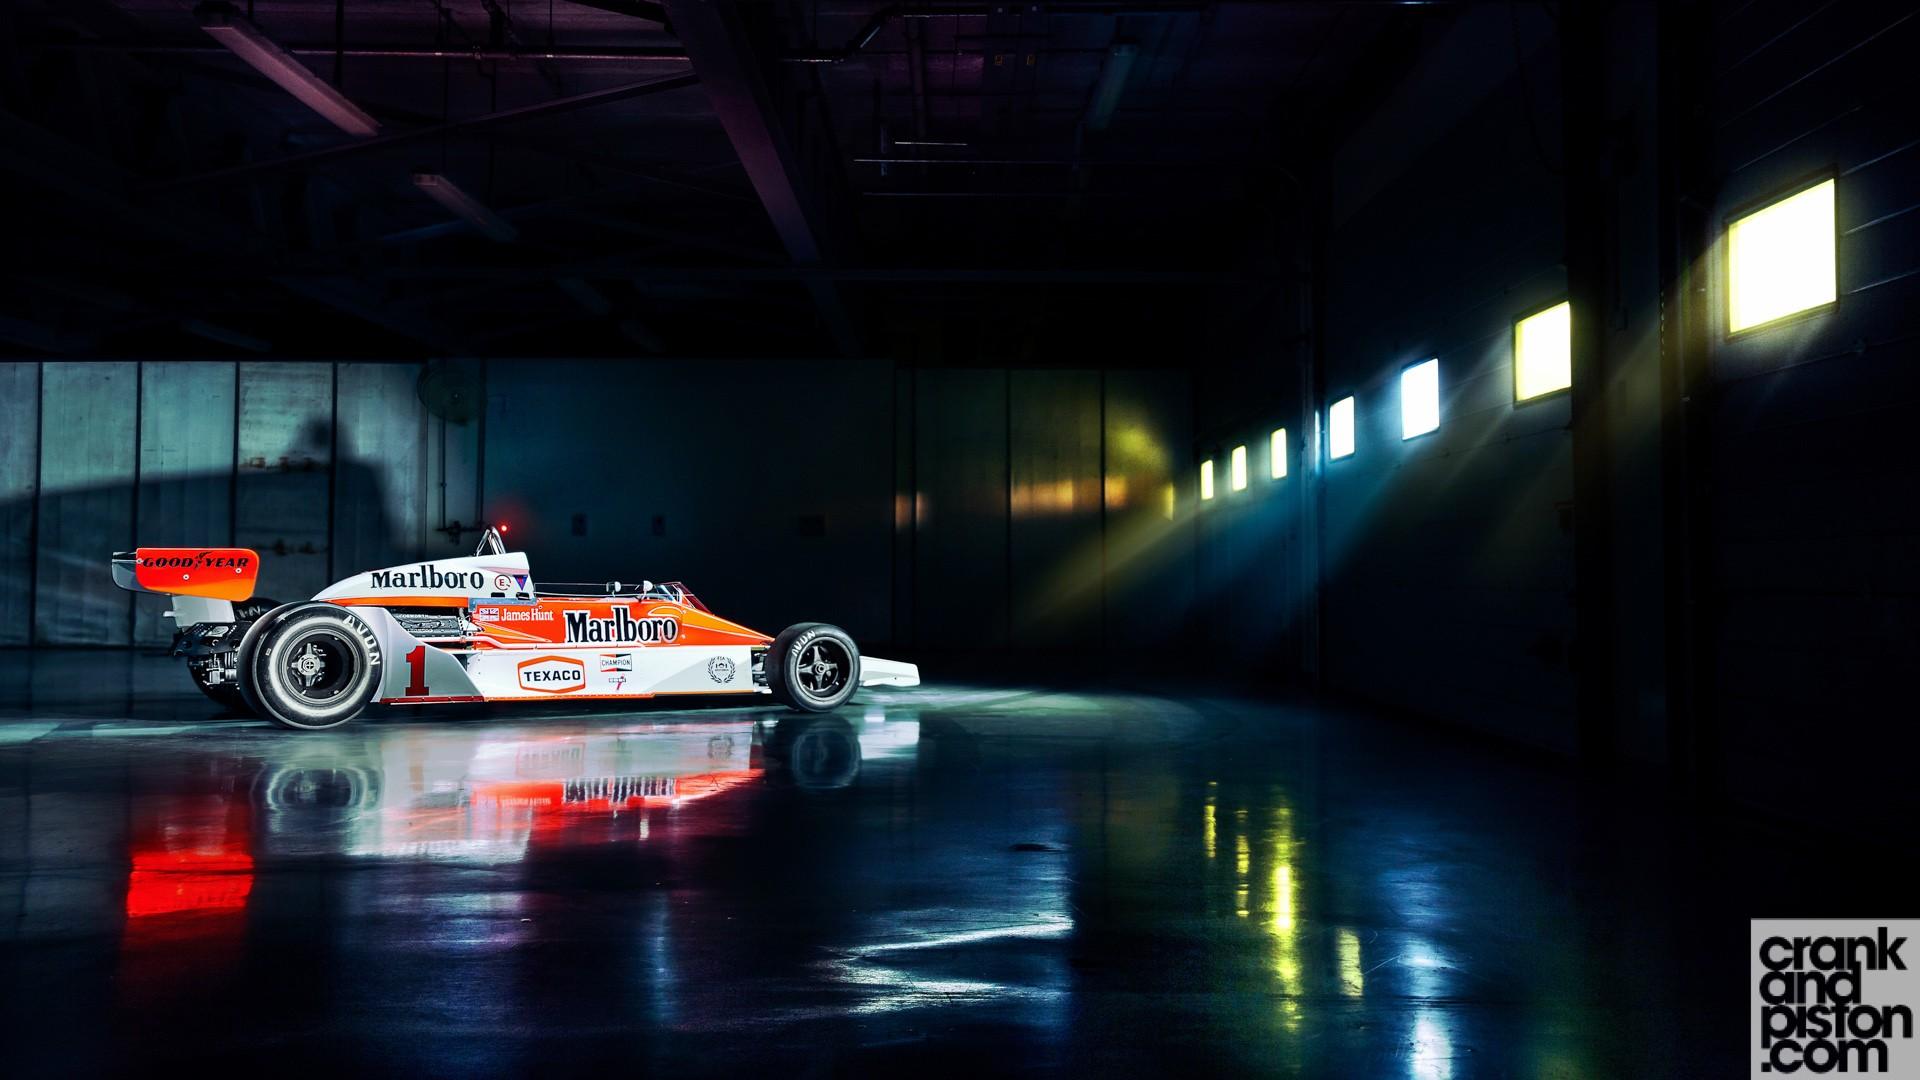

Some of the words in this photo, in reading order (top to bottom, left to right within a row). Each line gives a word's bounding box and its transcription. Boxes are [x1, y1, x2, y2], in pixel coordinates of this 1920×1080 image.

[371, 564, 484, 589] Marlboro
[501, 608, 530, 622] James
[531, 608, 554, 621] Hunt
[565, 606, 677, 643] Marlboro
[343, 614, 381, 667] AVON
[791, 630, 816, 657] AVON
[405, 645, 430, 696] 1
[523, 669, 581, 682] TEXACO
